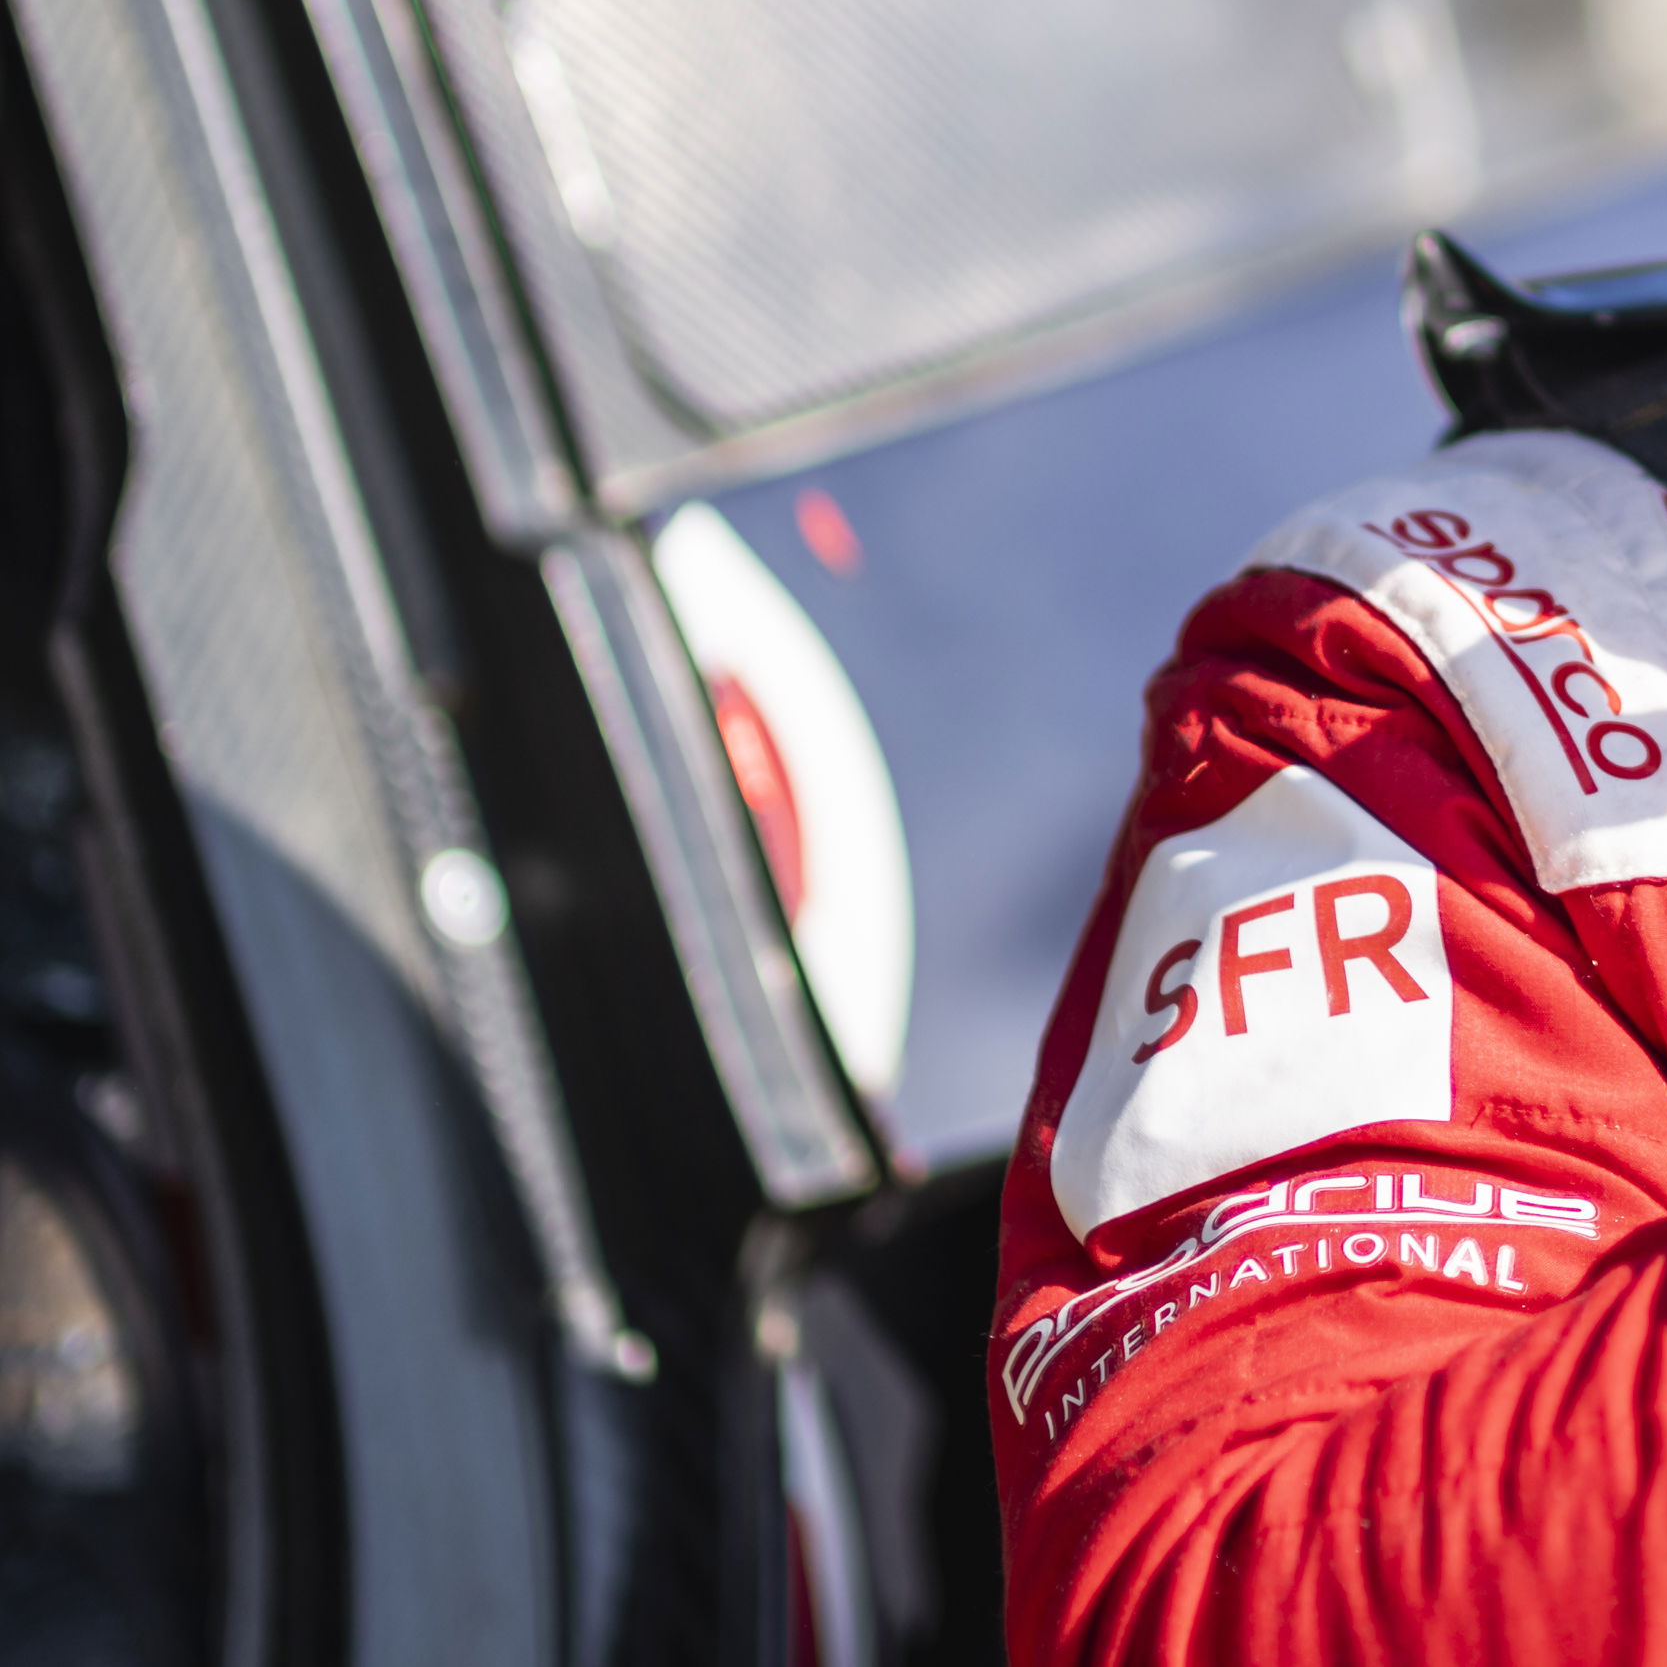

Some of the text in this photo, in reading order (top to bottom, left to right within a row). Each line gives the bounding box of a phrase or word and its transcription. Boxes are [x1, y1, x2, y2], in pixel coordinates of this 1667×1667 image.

[1388, 508, 1662, 784] sparco
[1130, 872, 1430, 1065] SFR
[1044, 1232, 1529, 1441] INTERNATIONAL
